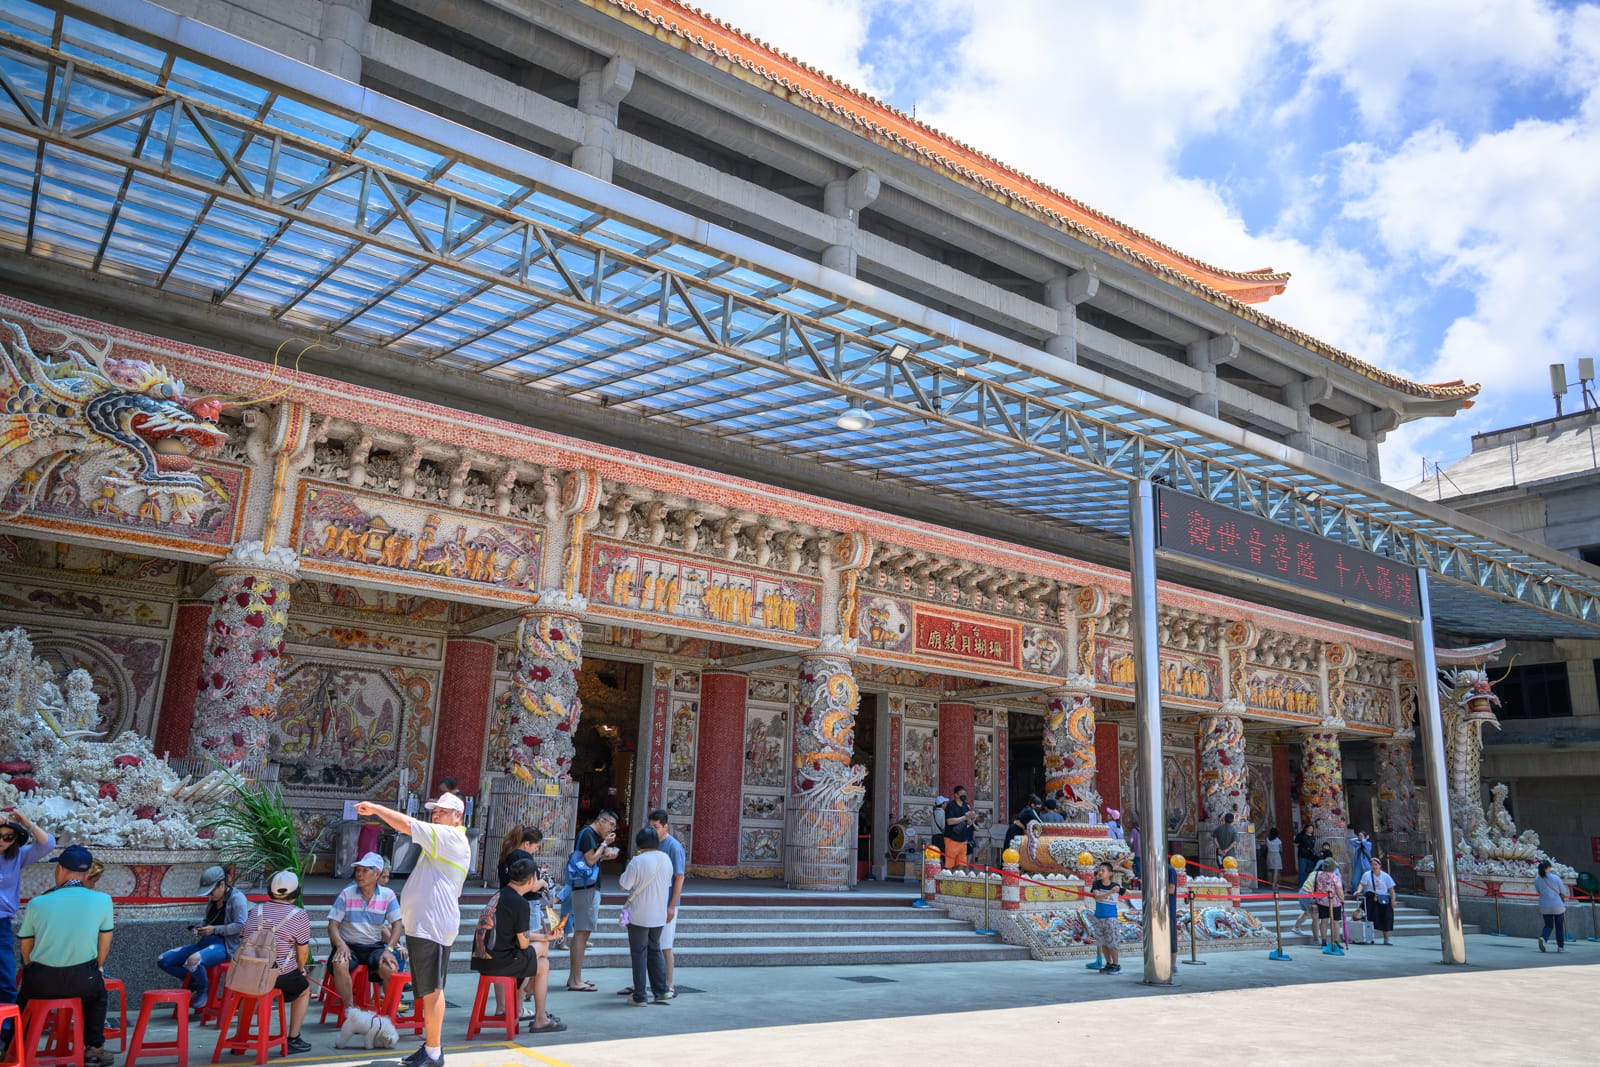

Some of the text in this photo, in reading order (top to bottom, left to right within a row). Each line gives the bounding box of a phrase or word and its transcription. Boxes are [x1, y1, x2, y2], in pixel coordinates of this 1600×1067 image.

[1187, 509, 1319, 581] 觀世音菩薩
[1335, 552, 1416, 608] 十八羅漢
